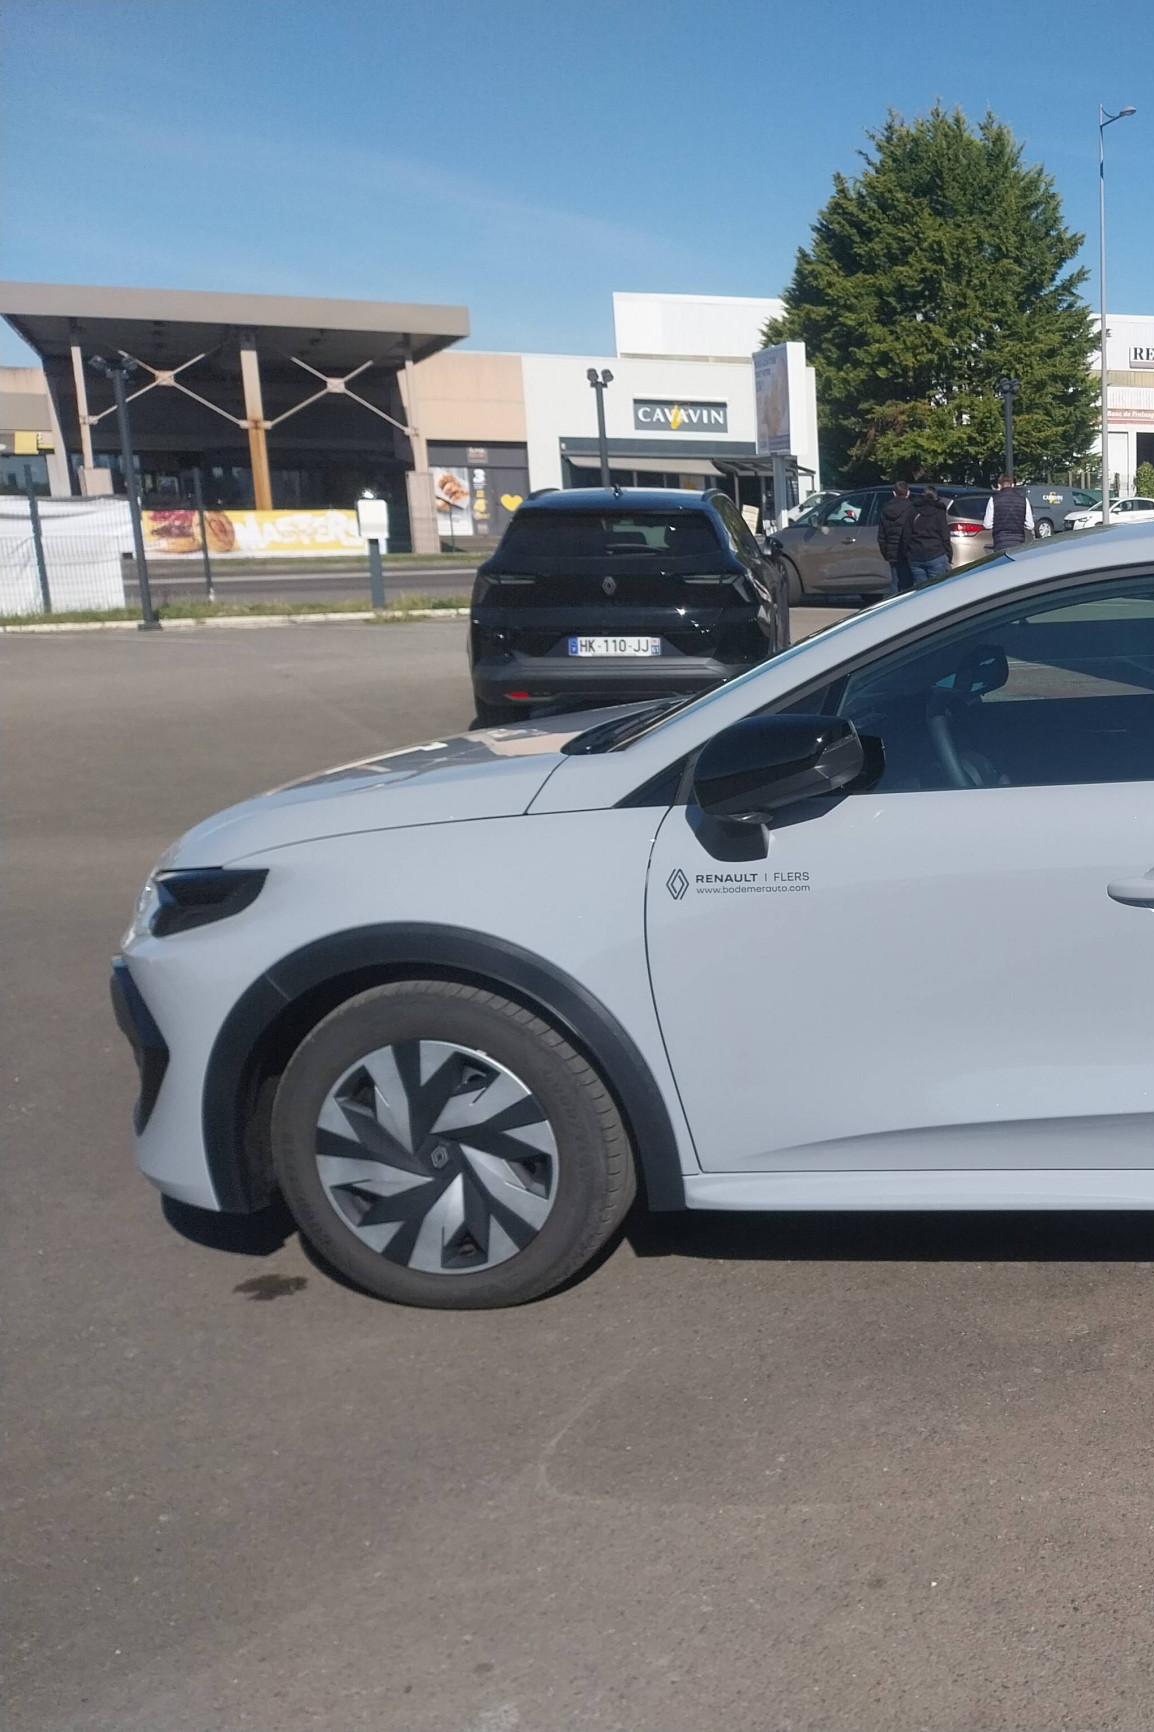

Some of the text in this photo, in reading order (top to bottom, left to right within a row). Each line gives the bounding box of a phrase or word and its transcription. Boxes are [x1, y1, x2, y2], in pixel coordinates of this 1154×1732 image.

[637, 405, 725, 426] CAVAVIN
[580, 639, 649, 652] HK-110-JJ
[695, 871, 810, 884] RENAULT FLERS
[696, 884, 811, 894] www.bodemerauto.com
